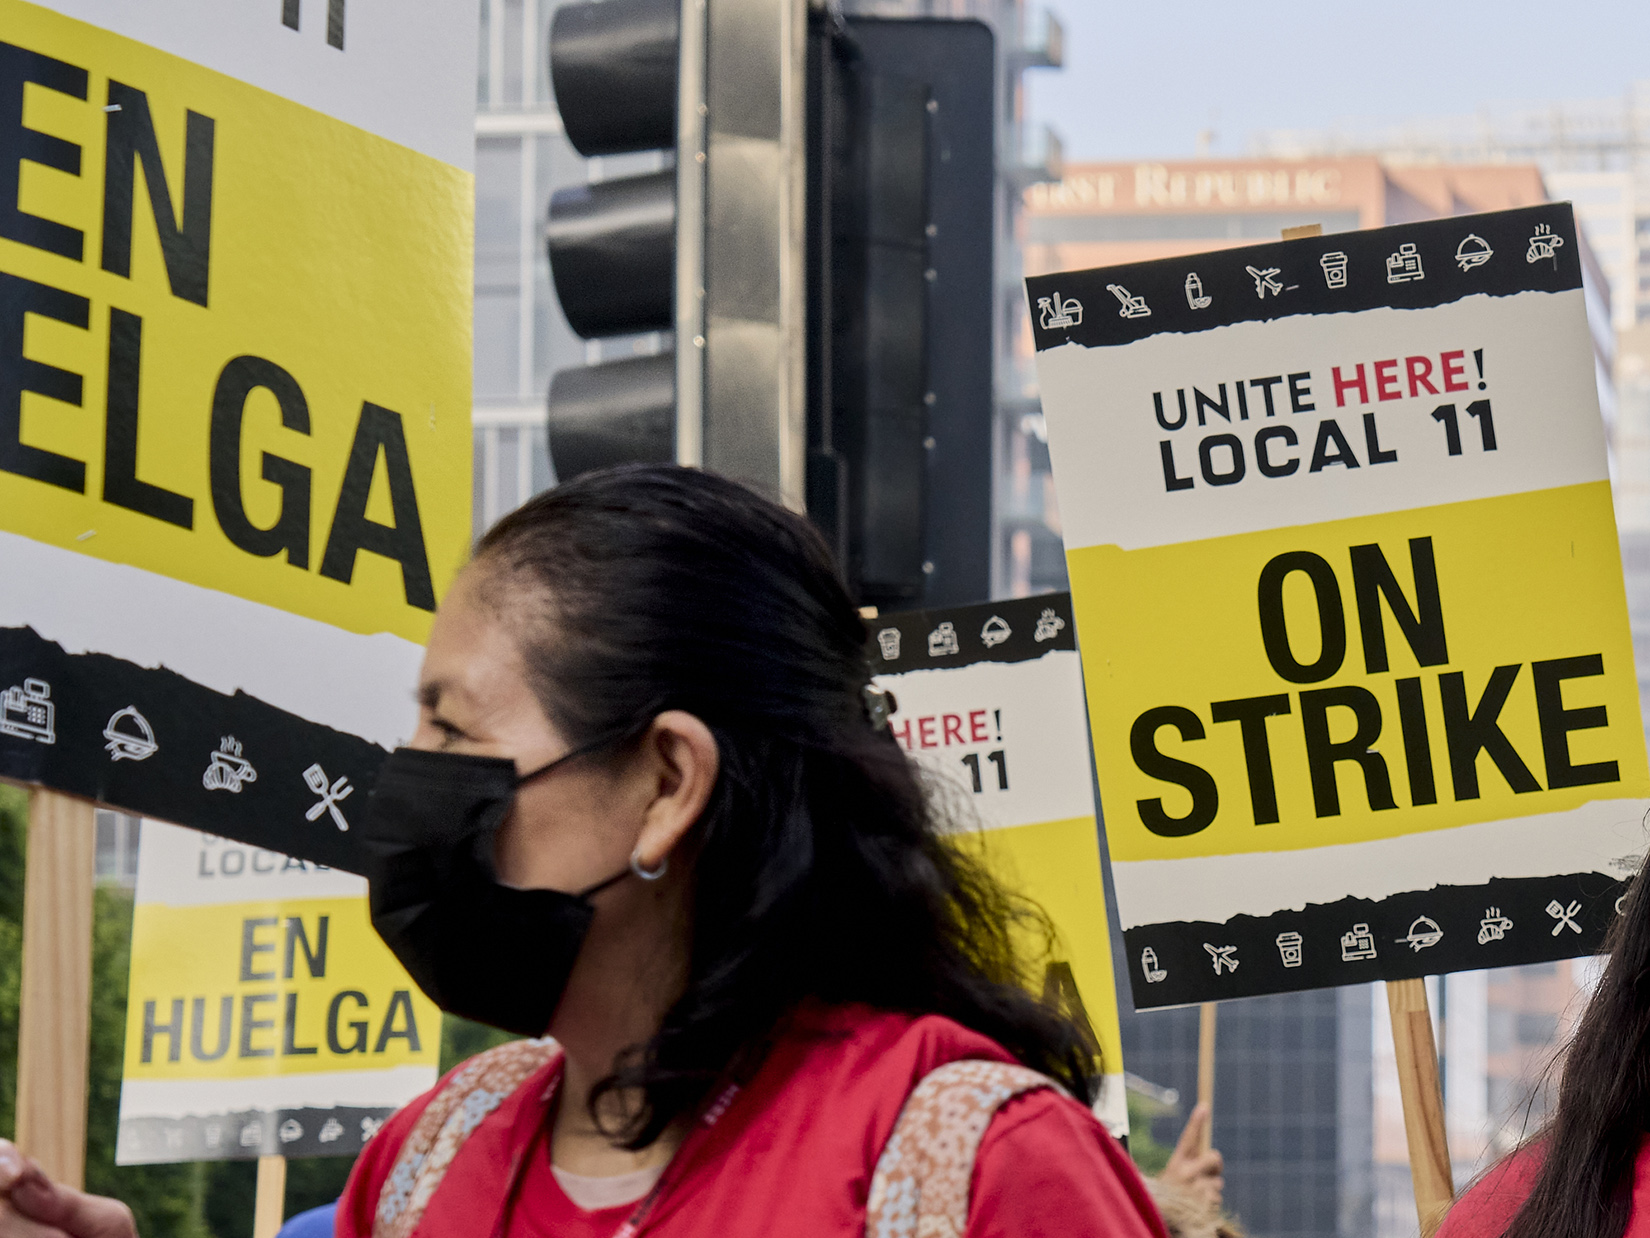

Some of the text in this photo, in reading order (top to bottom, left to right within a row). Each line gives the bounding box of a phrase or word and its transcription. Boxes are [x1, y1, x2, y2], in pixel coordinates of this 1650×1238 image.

[0, 40, 216, 310] EN
[1152, 348, 1488, 432] UNITE HERE!
[0, 270, 438, 613] ELGA
[1158, 398, 1499, 493] LOCAL 11
[1256, 535, 1450, 685] ON
[889, 709, 1004, 751] HERE!
[961, 750, 1010, 793] 11
[1128, 652, 1621, 838] STRIKE
[239, 915, 330, 982] EN
[140, 989, 422, 1063] HUELGA
